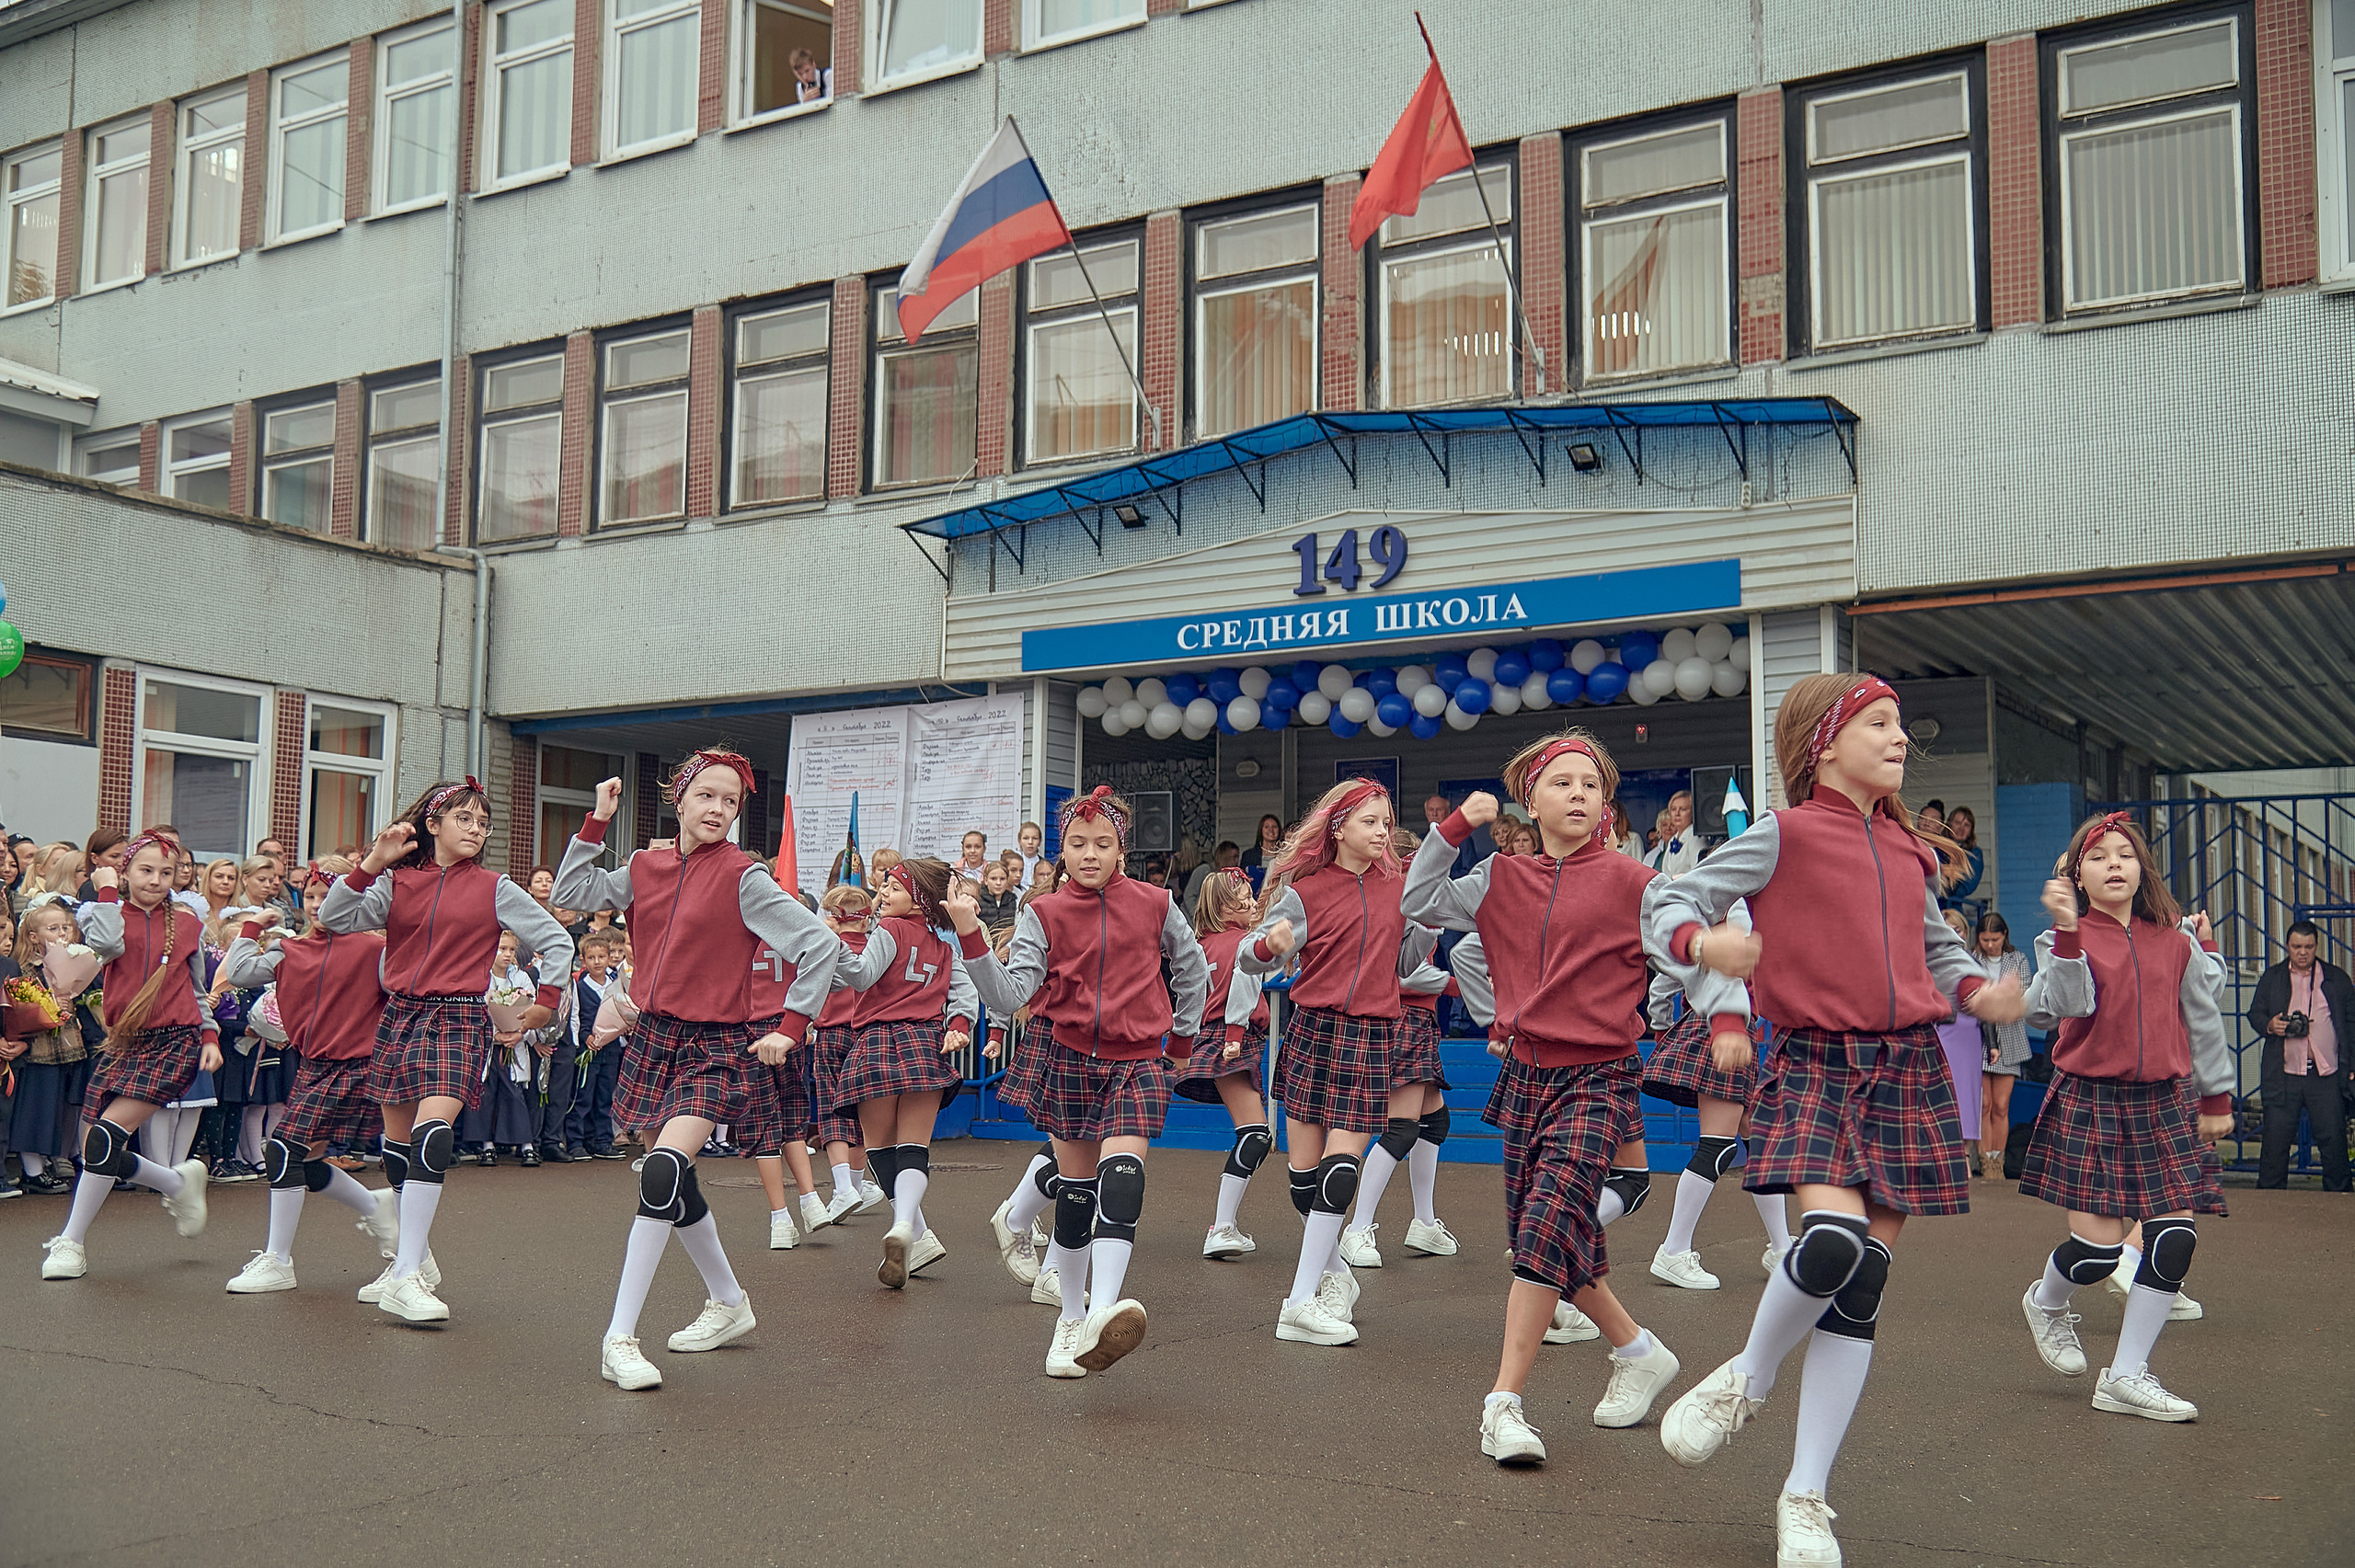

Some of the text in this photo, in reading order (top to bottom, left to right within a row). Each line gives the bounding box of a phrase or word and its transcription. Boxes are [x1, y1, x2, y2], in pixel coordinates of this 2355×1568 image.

[1292, 526, 1407, 596] 149
[1178, 592, 1528, 650] СРЕДНЯЯ ШКОЛА
[873, 720, 891, 729] 2022
[988, 710, 1007, 719] 2022
